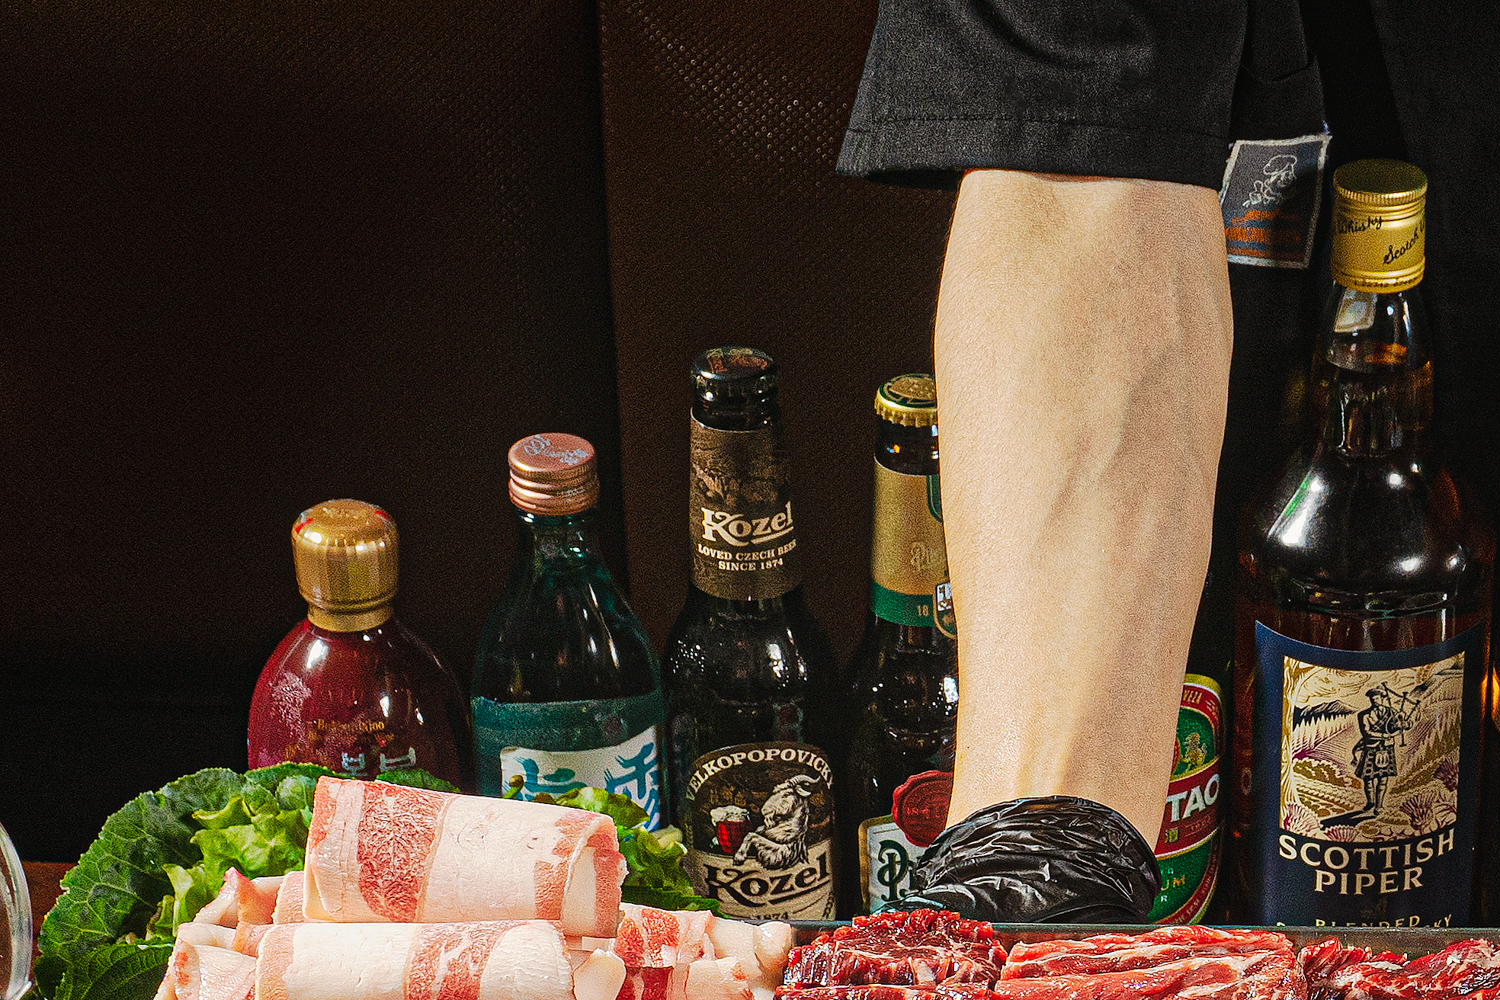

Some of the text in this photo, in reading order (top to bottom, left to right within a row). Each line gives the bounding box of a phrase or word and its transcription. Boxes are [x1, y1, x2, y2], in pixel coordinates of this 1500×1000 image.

[1383, 227, 1419, 265] Scotch
[701, 501, 794, 546] Kozel
[697, 543, 732, 561] LOVED
[735, 548, 775, 561] CZECH
[718, 558, 784, 571] SINCE 1874
[1279, 828, 1455, 870] SCOTTISH
[704, 852, 831, 908] Kozel
[1314, 866, 1423, 895] PIPER
